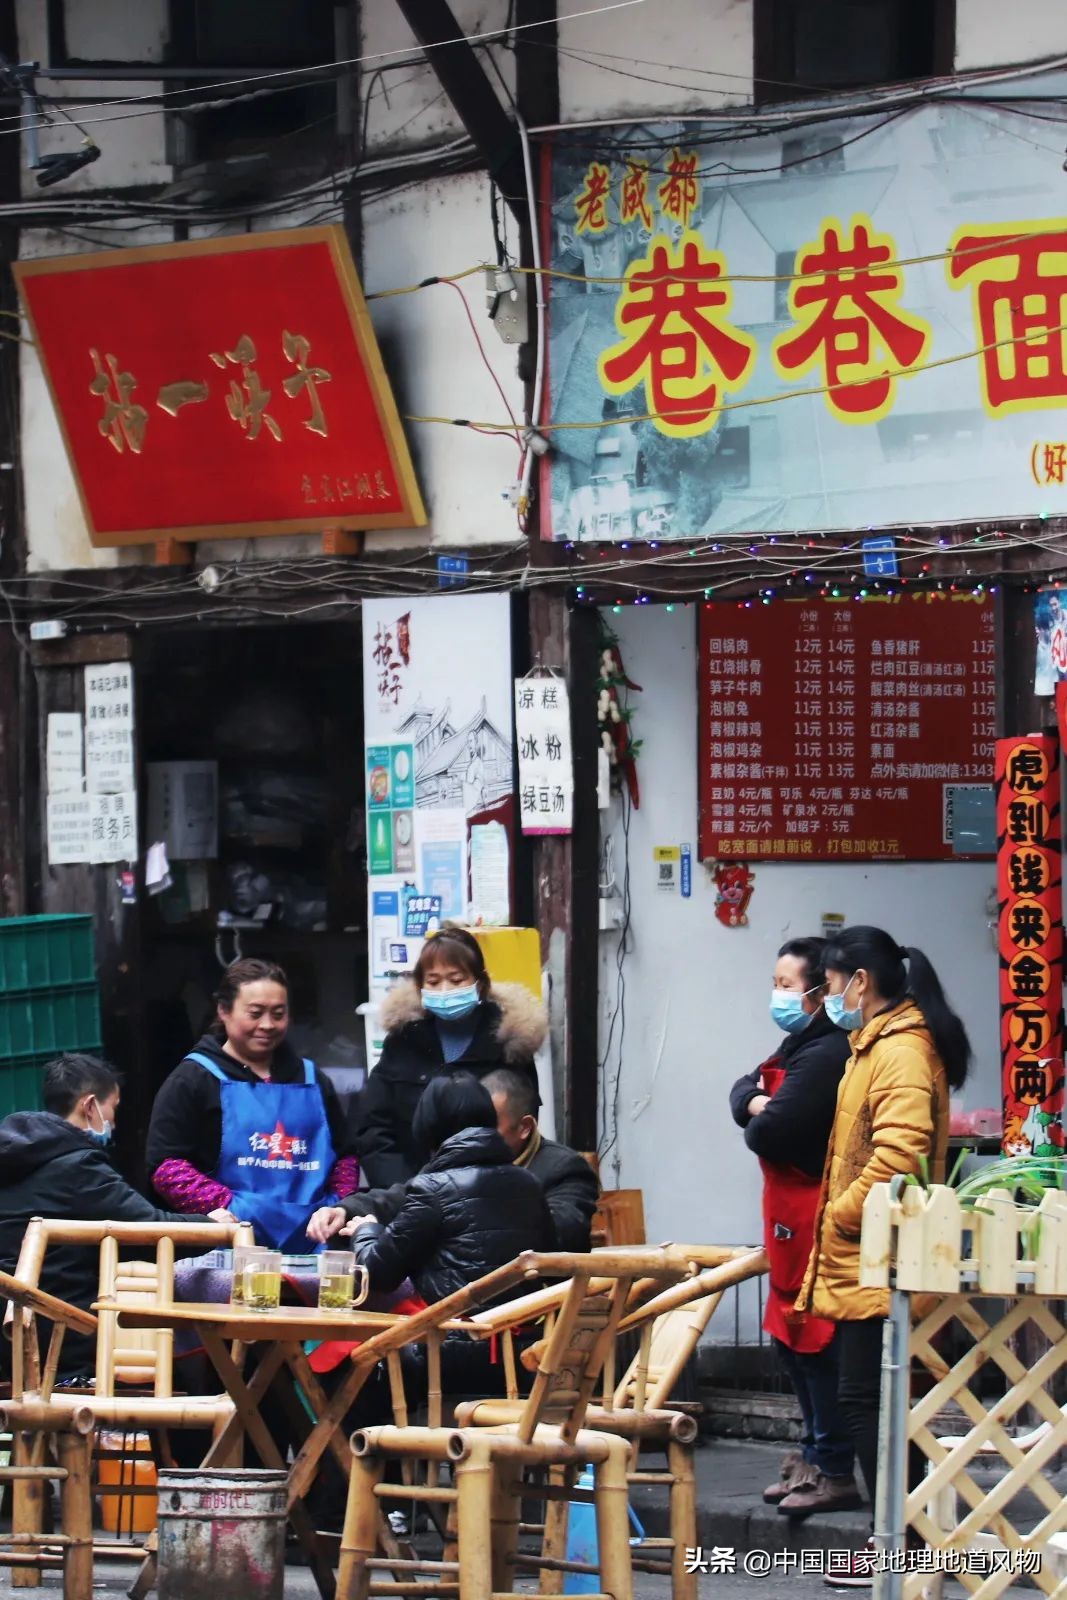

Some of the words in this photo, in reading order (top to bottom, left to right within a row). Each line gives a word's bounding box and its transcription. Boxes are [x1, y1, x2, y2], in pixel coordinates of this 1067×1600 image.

[576, 150, 698, 233] 老成都
[599, 213, 1067, 436] 巷巷面
[710, 638, 749, 654] 回锅肉
[794, 638, 822, 653] 12元
[828, 638, 855, 653] 14元
[871, 639, 920, 656] 鱼香猪肝
[710, 659, 762, 675] 红烧排骨
[794, 659, 822, 674] 12元
[828, 659, 855, 674] 14元
[710, 680, 763, 696] 笋子牛肉
[794, 680, 822, 695] 12元
[828, 680, 855, 695] 14元
[794, 701, 822, 716] 11元
[828, 701, 855, 716] 13元
[870, 702, 920, 718] 清汤杂酱
[710, 721, 762, 737] 青椒辣鸡
[794, 721, 822, 736] 11元
[828, 721, 855, 736] 13元
[870, 723, 920, 738] 红汤杂酱
[520, 733, 563, 760] 冰粉
[710, 742, 762, 758] 泡椒鸡杂
[794, 742, 822, 757] 11元
[828, 742, 855, 757] 13元
[870, 743, 895, 759] 素面
[794, 763, 822, 778] 11元
[828, 763, 855, 778] 13元
[870, 763, 997, 779] 点外卖请加微信:1343
[522, 785, 566, 813] 绿豆汤
[711, 787, 735, 800] 豆奶
[738, 787, 773, 800] 4元/瓶
[780, 787, 803, 800] 可乐
[809, 787, 843, 800] 4元/瓶
[849, 787, 872, 800] 芬达
[875, 788, 909, 800] 4元/瓶
[711, 804, 735, 817] 雪碧
[738, 804, 773, 817] 4元/瓶
[782, 804, 818, 817] 矿泉水
[821, 804, 855, 817] 2元/瓶
[711, 820, 735, 833] 煎蛋
[738, 820, 773, 833] 2元/个
